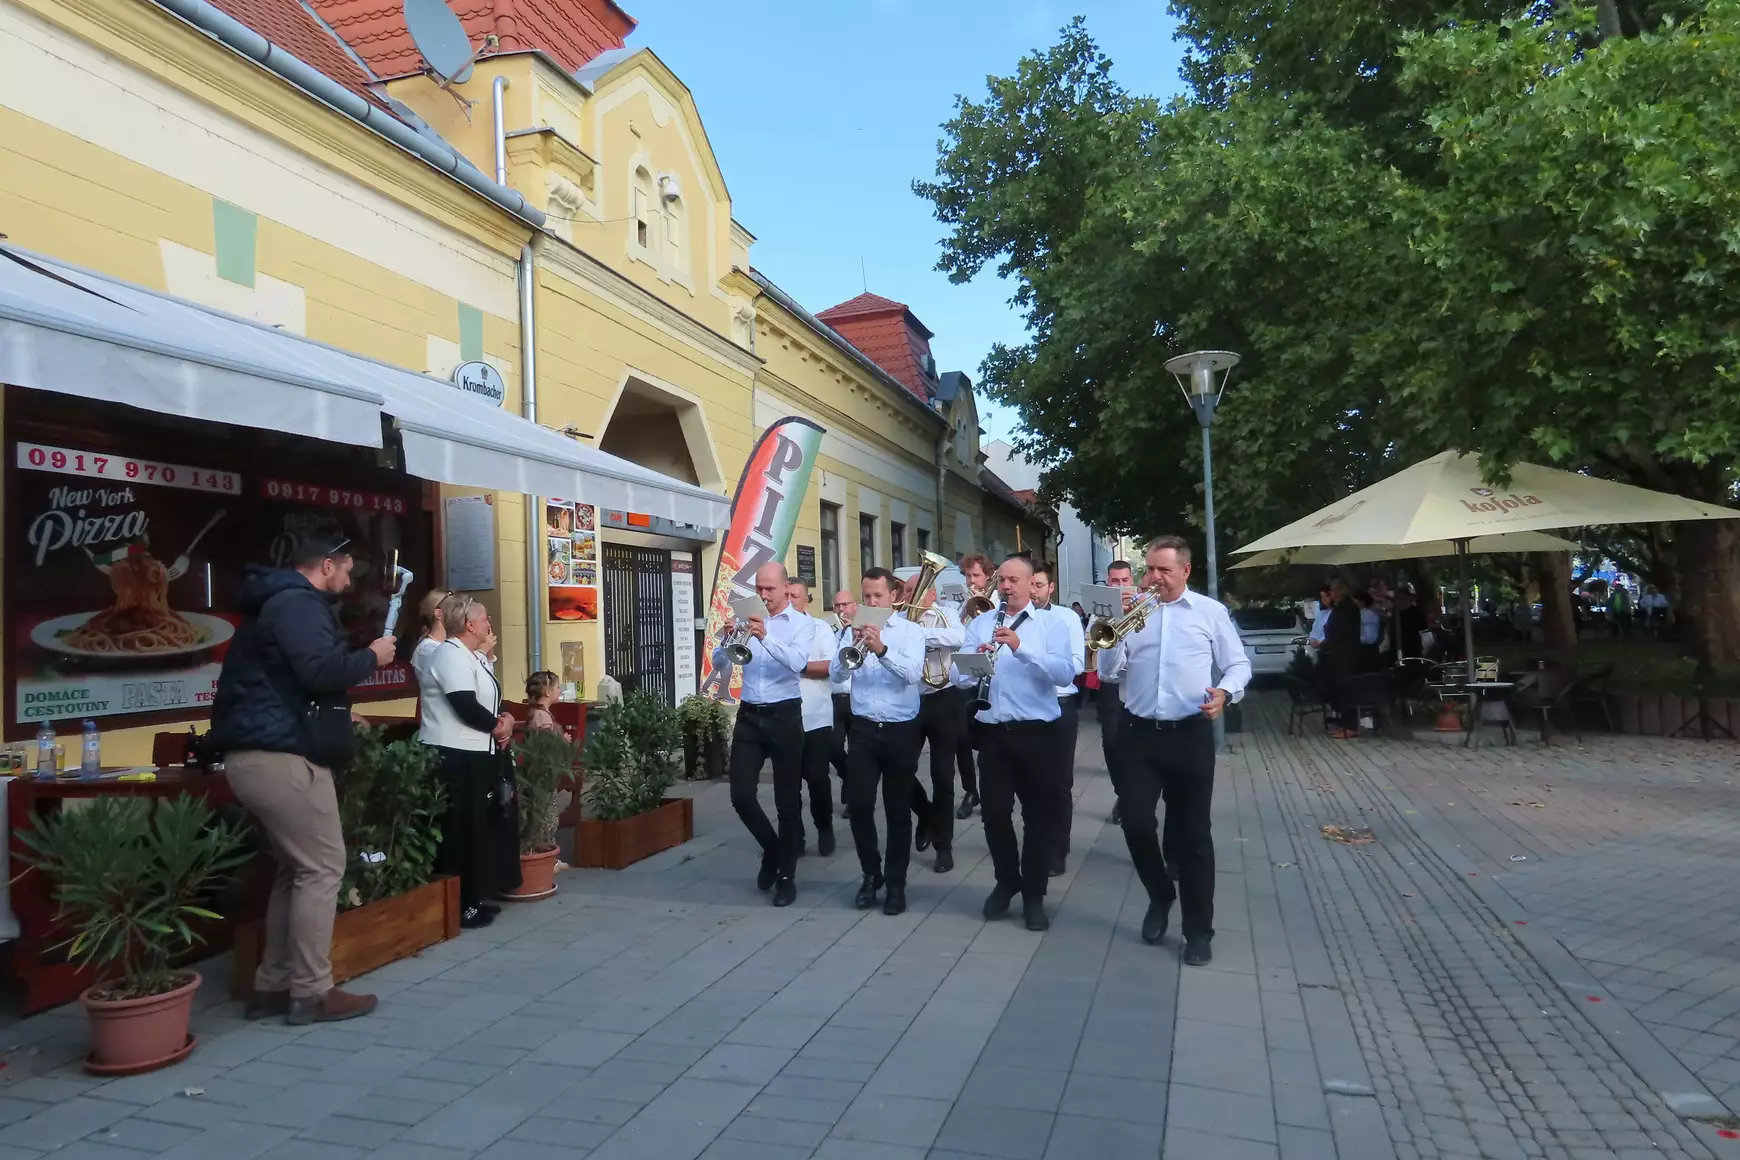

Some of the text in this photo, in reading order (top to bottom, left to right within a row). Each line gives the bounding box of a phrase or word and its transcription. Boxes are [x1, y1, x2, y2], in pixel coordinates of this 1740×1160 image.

[462, 375, 502, 400] Krombacher
[28, 448, 234, 490] 0917 970 143
[49, 486, 136, 509] New York
[267, 481, 403, 512] 0917 970 143
[1460, 494, 1543, 514] kofola
[28, 509, 149, 566] Pizza
[700, 432, 804, 704] PIZA
[24, 688, 90, 703] DOMÁCE
[121, 680, 188, 709] PASTA
[24, 700, 110, 717] CESTOVINY
